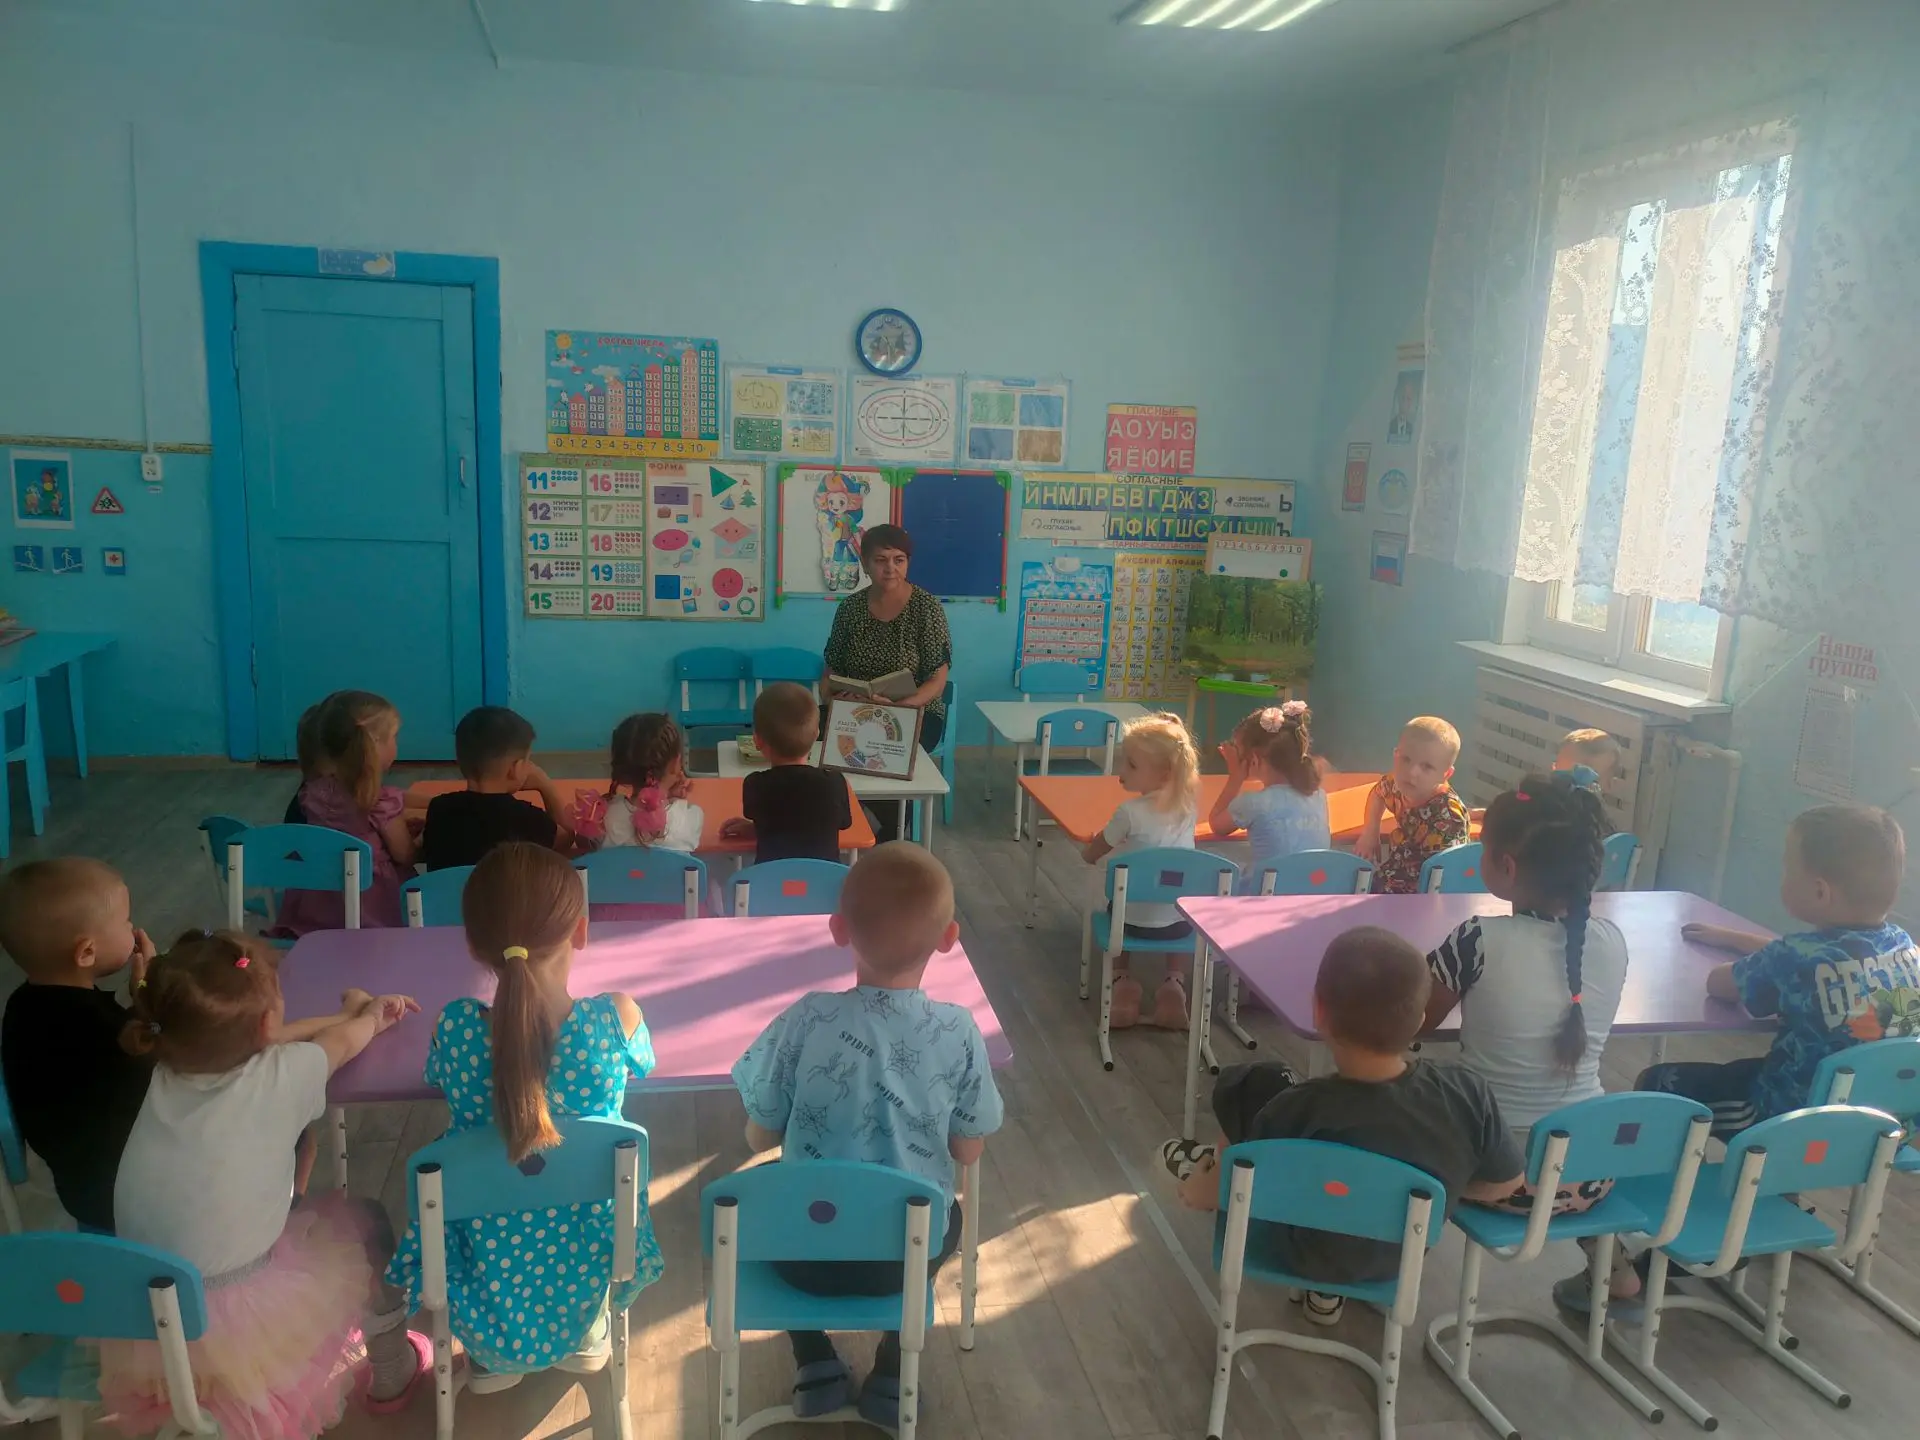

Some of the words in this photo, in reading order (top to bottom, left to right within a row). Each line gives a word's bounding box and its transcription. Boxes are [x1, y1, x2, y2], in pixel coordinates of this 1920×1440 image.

[1126, 406, 1180, 416] ГЛАСНЫЕ
[556, 438, 563, 447] 0
[570, 439, 574, 447] 1
[581, 439, 588, 448] 2
[595, 440, 602, 449] 3
[609, 440, 615, 449] 4
[623, 441, 629, 450] 5
[636, 441, 643, 450] 6
[650, 442, 657, 450] 7
[664, 442, 670, 451] 8
[677, 443, 684, 452] 9
[691, 443, 704, 452] 10
[649, 463, 685, 471] ФОРМА
[527, 472, 548, 490] 11
[589, 474, 612, 492] 16
[1116, 474, 1184, 486] СОГЛАСНЫЕ
[528, 502, 552, 521] 12
[590, 504, 614, 522] 17
[529, 533, 551, 551] 13
[590, 534, 613, 552] 18
[529, 563, 554, 581] 14
[591, 564, 614, 582] 19
[530, 593, 553, 610] 15
[591, 593, 615, 611] 20
[1816, 634, 1875, 663] Наша
[1808, 656, 1877, 681] группа
[838, 1030, 875, 1058] SPIDER
[873, 1080, 904, 1109] SPIDER
